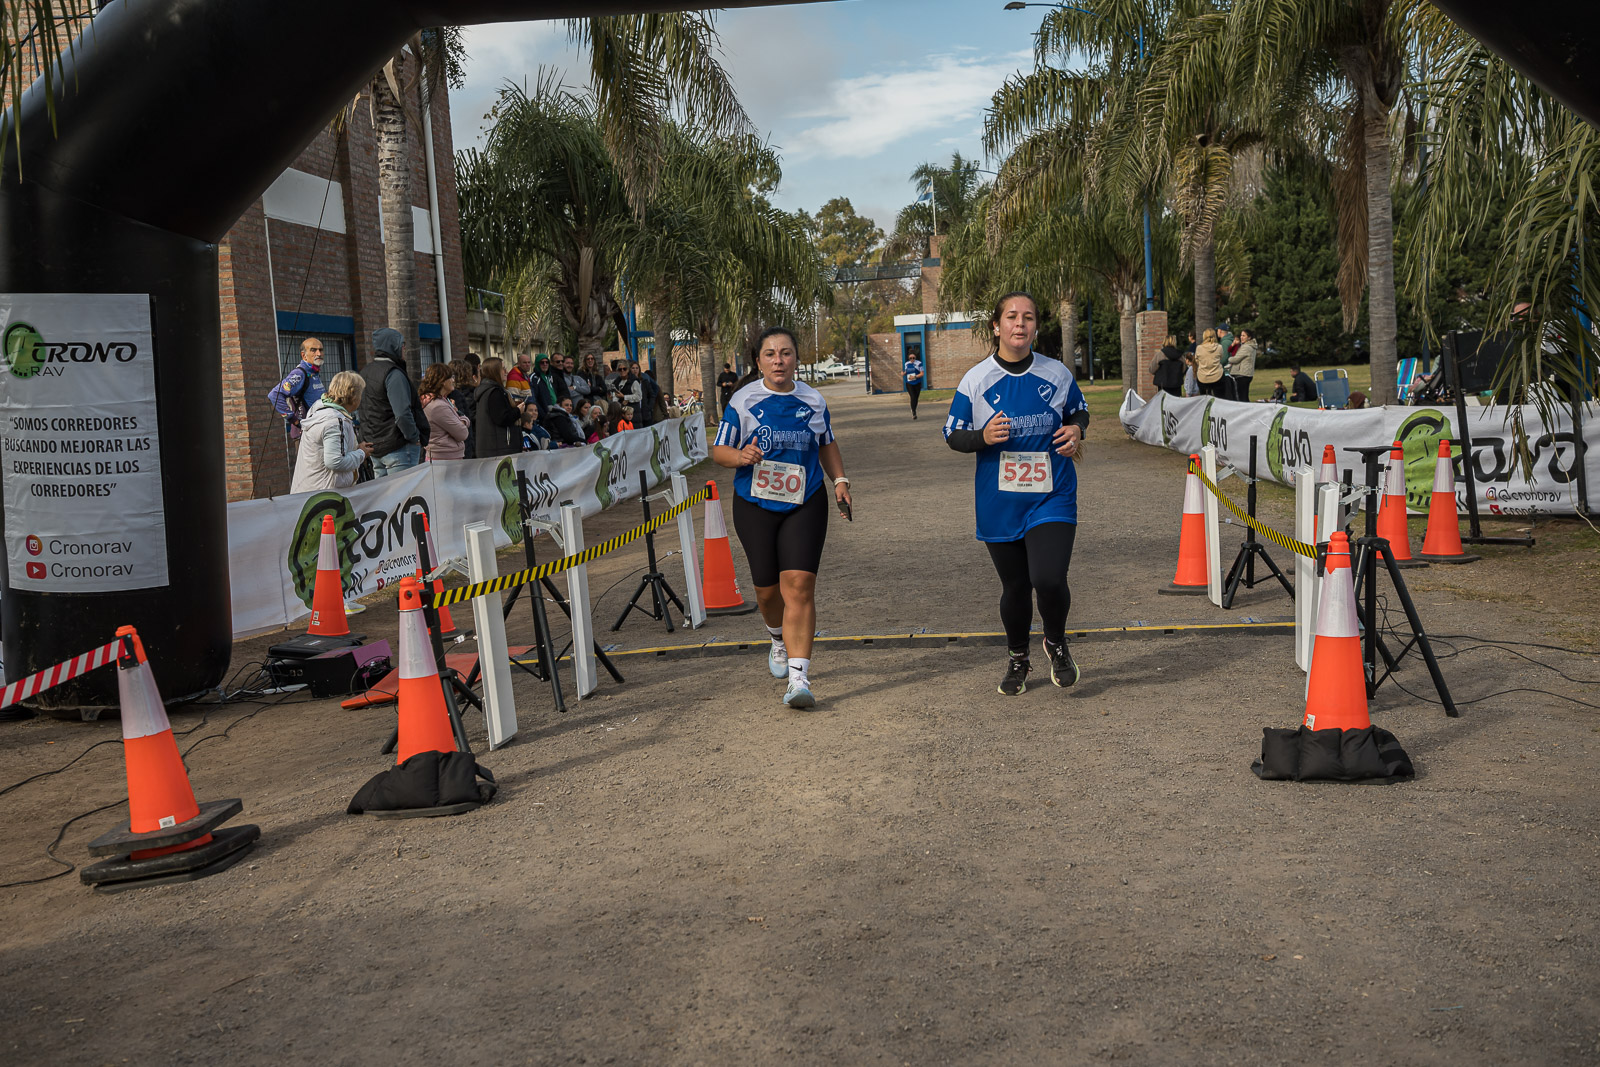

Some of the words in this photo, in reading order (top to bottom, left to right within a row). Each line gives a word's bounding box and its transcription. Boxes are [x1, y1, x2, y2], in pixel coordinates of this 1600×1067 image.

[31, 342, 138, 363] CRONO
[31, 366, 65, 377] RAV
[9, 416, 49, 431] “SOMOS
[51, 416, 138, 431] CORREDORES
[5, 438, 58, 454] BUSCANDO
[60, 438, 125, 454] MEJORAR
[127, 437, 151, 451] LAS
[757, 425, 772, 453] 3
[13, 460, 92, 476] EXPERIENCIAS
[95, 461, 113, 475] DE
[116, 459, 140, 474] LOS
[1004, 462, 1048, 482] 525
[756, 469, 802, 493] 530
[31, 482, 117, 498] CORREDORES”
[1498, 489, 1561, 502] @cronorav
[49, 539, 133, 555] Cronorav
[51, 561, 134, 578] Cronorav
